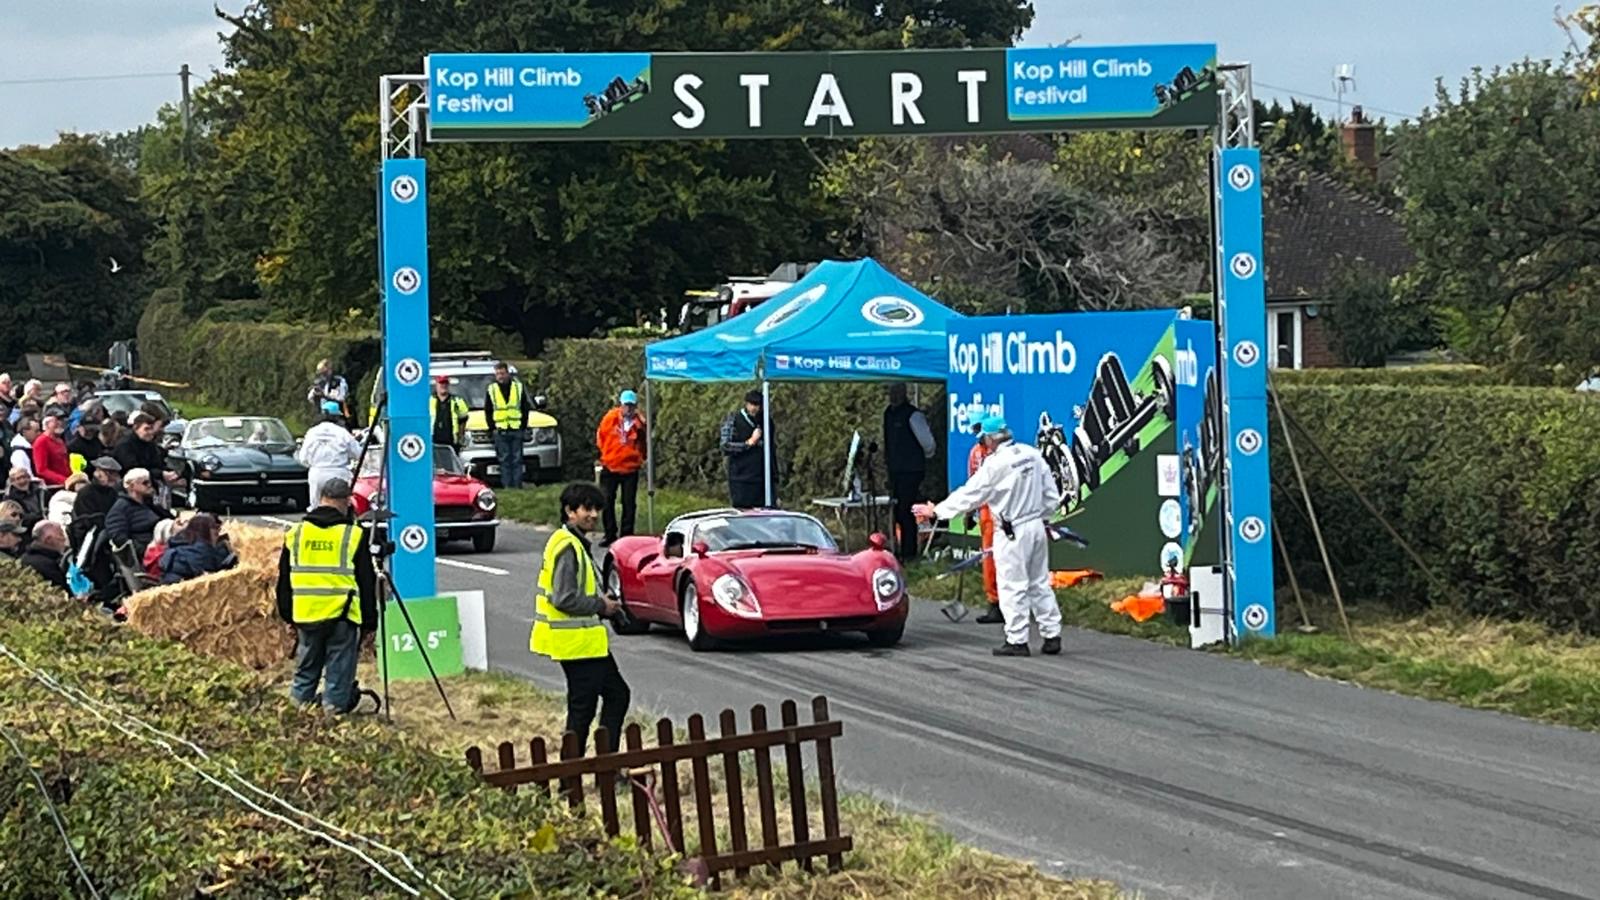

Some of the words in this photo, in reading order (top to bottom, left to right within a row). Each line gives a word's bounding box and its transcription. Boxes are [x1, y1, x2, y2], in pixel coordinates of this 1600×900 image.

[436, 67, 478, 90] Kop
[484, 67, 514, 87] Hill
[519, 66, 582, 87] Climb
[1013, 61, 1053, 83] Kop
[1059, 59, 1087, 78] Hill
[1092, 58, 1152, 77] Climb
[436, 94, 514, 112] Festival
[671, 69, 988, 129] START
[1014, 85, 1087, 105] Festival
[793, 356, 825, 372] Kop
[828, 356, 851, 369] Hill
[855, 355, 902, 370] Climb
[948, 333, 979, 384] Kop
[981, 332, 1004, 373] Hill
[1006, 330, 1077, 375] Climb
[304, 539, 335, 552] PRESS
